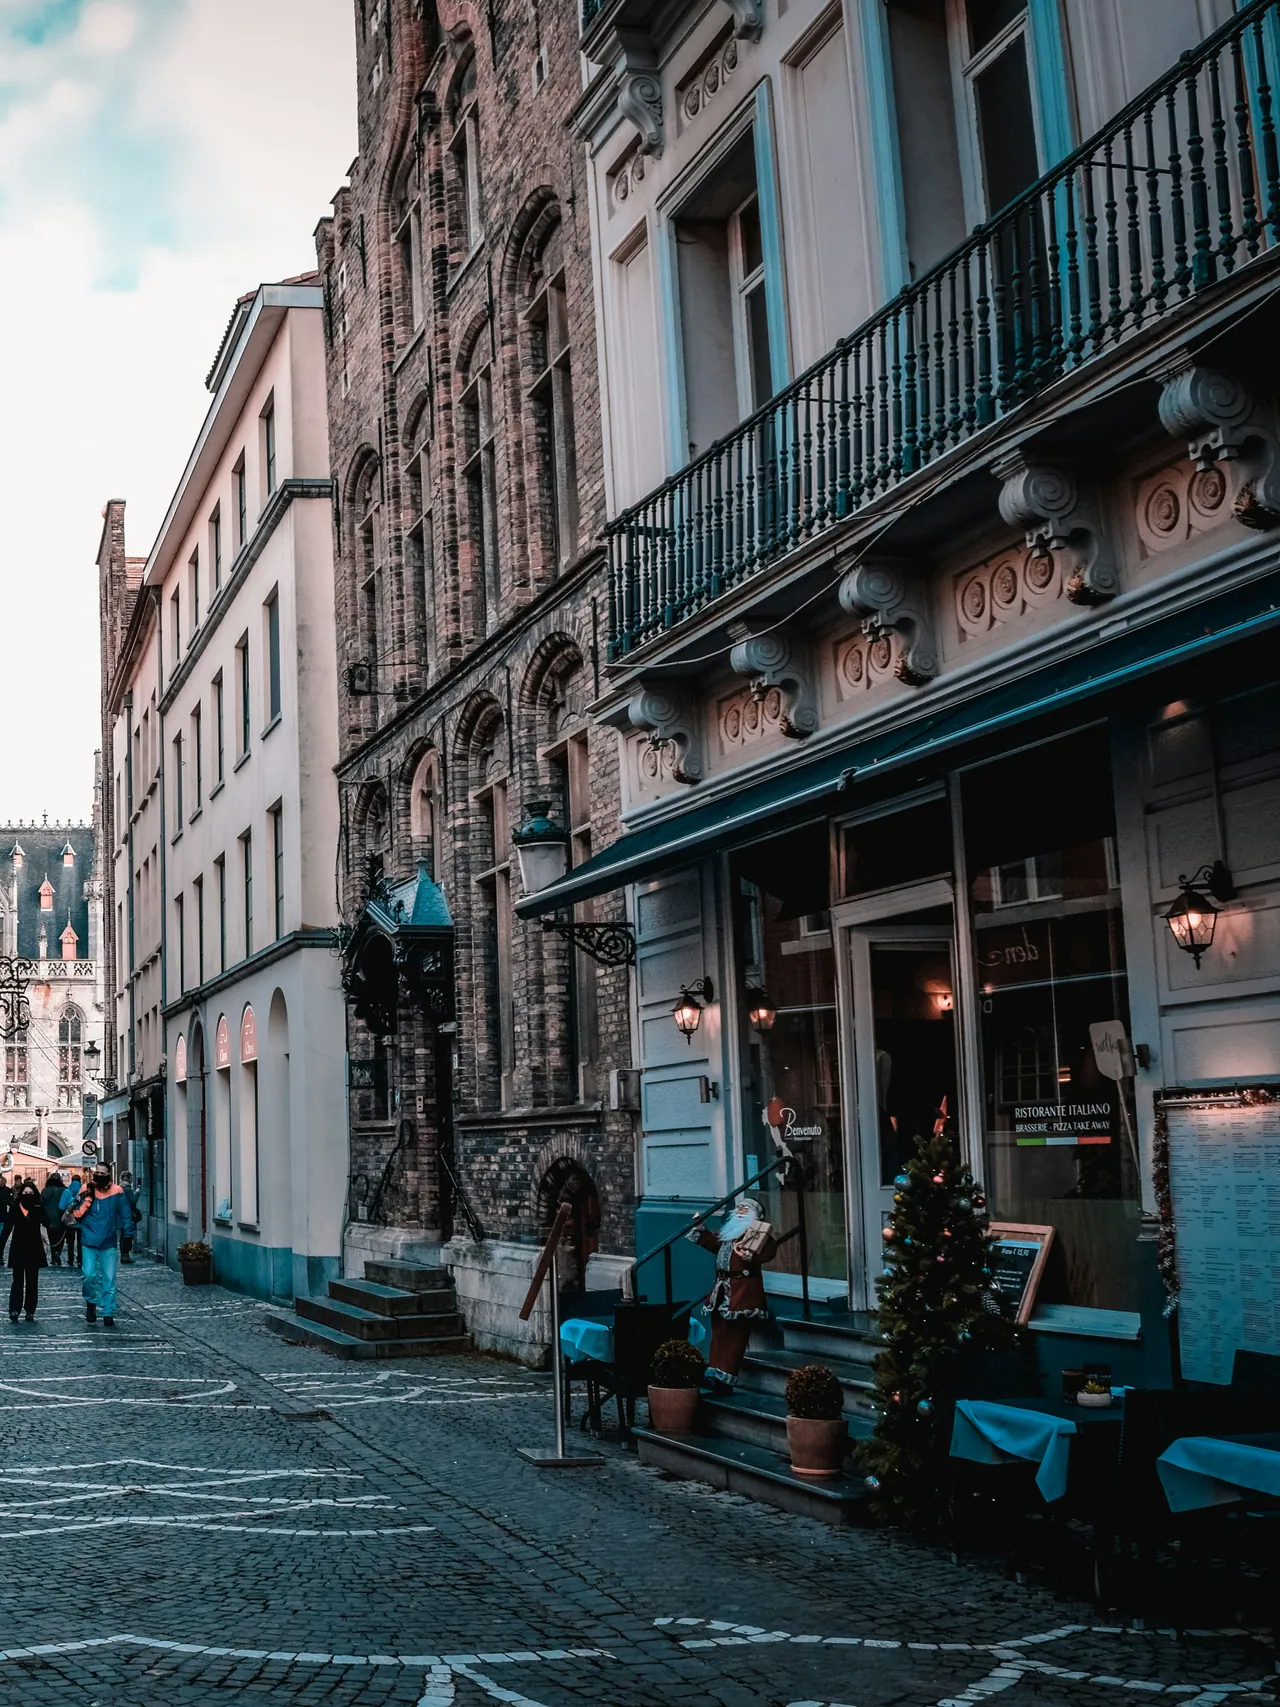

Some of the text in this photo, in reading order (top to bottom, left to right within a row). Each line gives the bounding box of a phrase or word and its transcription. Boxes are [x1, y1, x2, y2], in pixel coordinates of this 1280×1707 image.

[1014, 1103, 1111, 1119] RISTORANTE ITALIANO
[779, 1107, 822, 1137] Benvenuto
[1015, 1123, 1048, 1133] BRASSERIE
[1053, 1122, 1072, 1131] PIZZA
[1073, 1121, 1090, 1130] TAKE
[1091, 1120, 1111, 1130] AWAY
